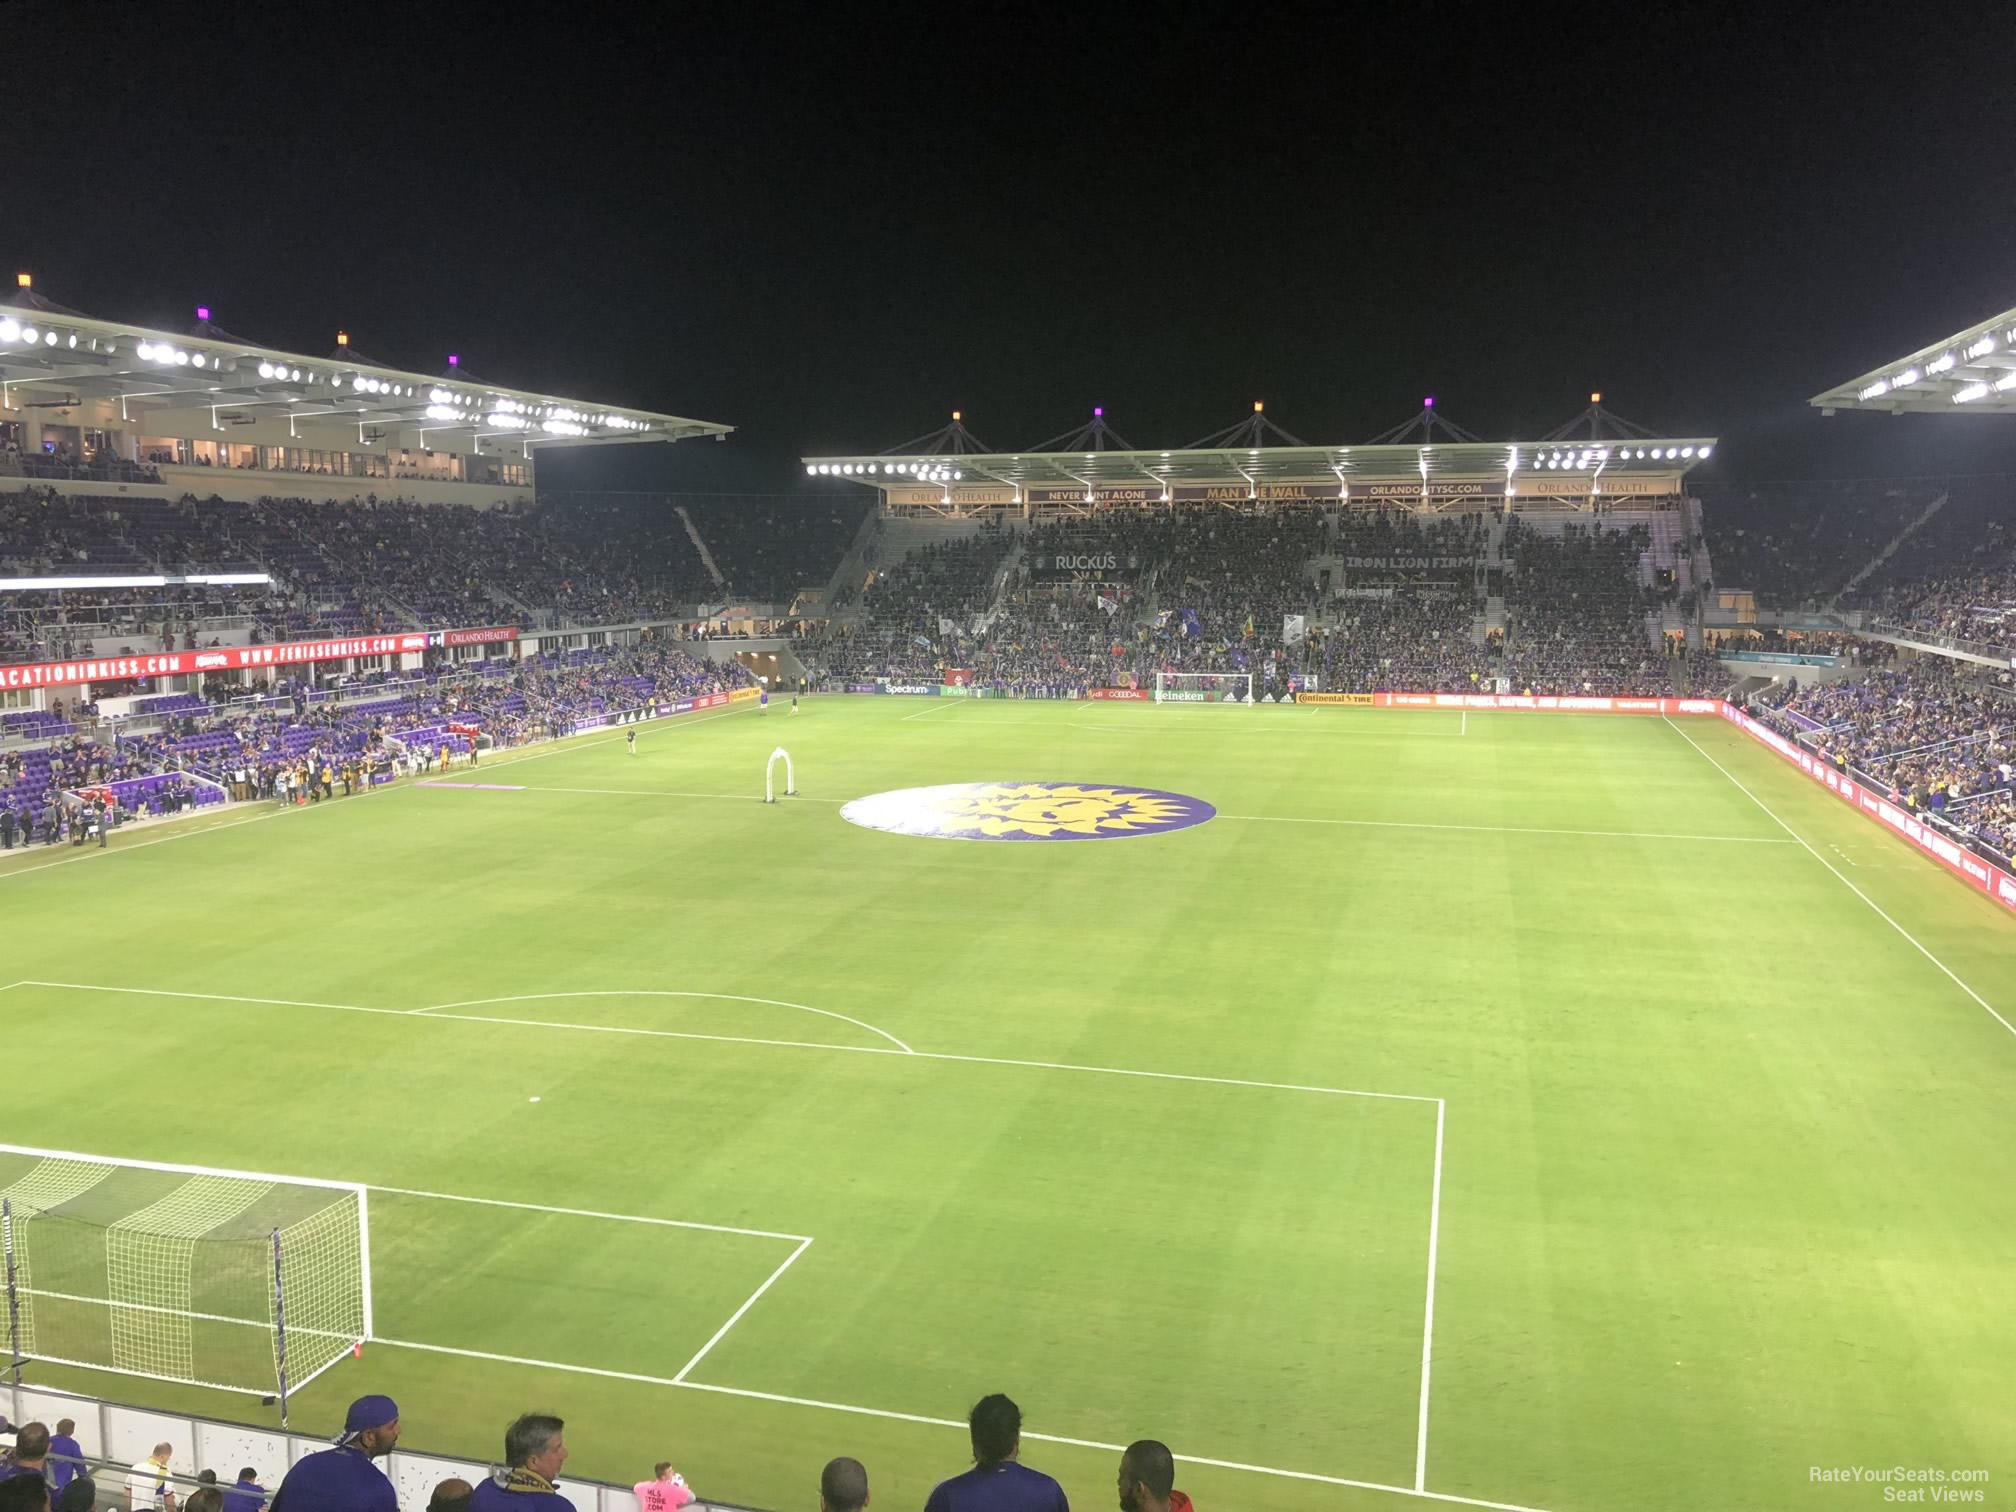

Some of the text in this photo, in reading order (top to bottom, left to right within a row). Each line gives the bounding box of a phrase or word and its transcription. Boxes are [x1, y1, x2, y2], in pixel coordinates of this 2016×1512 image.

[1207, 487, 1239, 498] MAN
[1271, 486, 1307, 497] WALL
[1369, 484, 1482, 495] ORLANDOITYSC.COM
[1600, 482, 1648, 493] HEALTH
[911, 492, 1001, 502] ORLANO HEALTH
[1049, 491, 1080, 500] NEVER
[1112, 490, 1146, 499] ALONE
[1055, 555, 1117, 570] RUCKUS
[1346, 555, 1474, 569] IRON LION FIRM
[450, 631, 510, 644] ORLANDO HEALTH
[885, 684, 930, 695] Spectrum
[1154, 690, 1204, 701] Heineken
[1298, 693, 1345, 704] Continental
[647, 1488, 661, 1497] MLS
[645, 1496, 666, 1504] STORE
